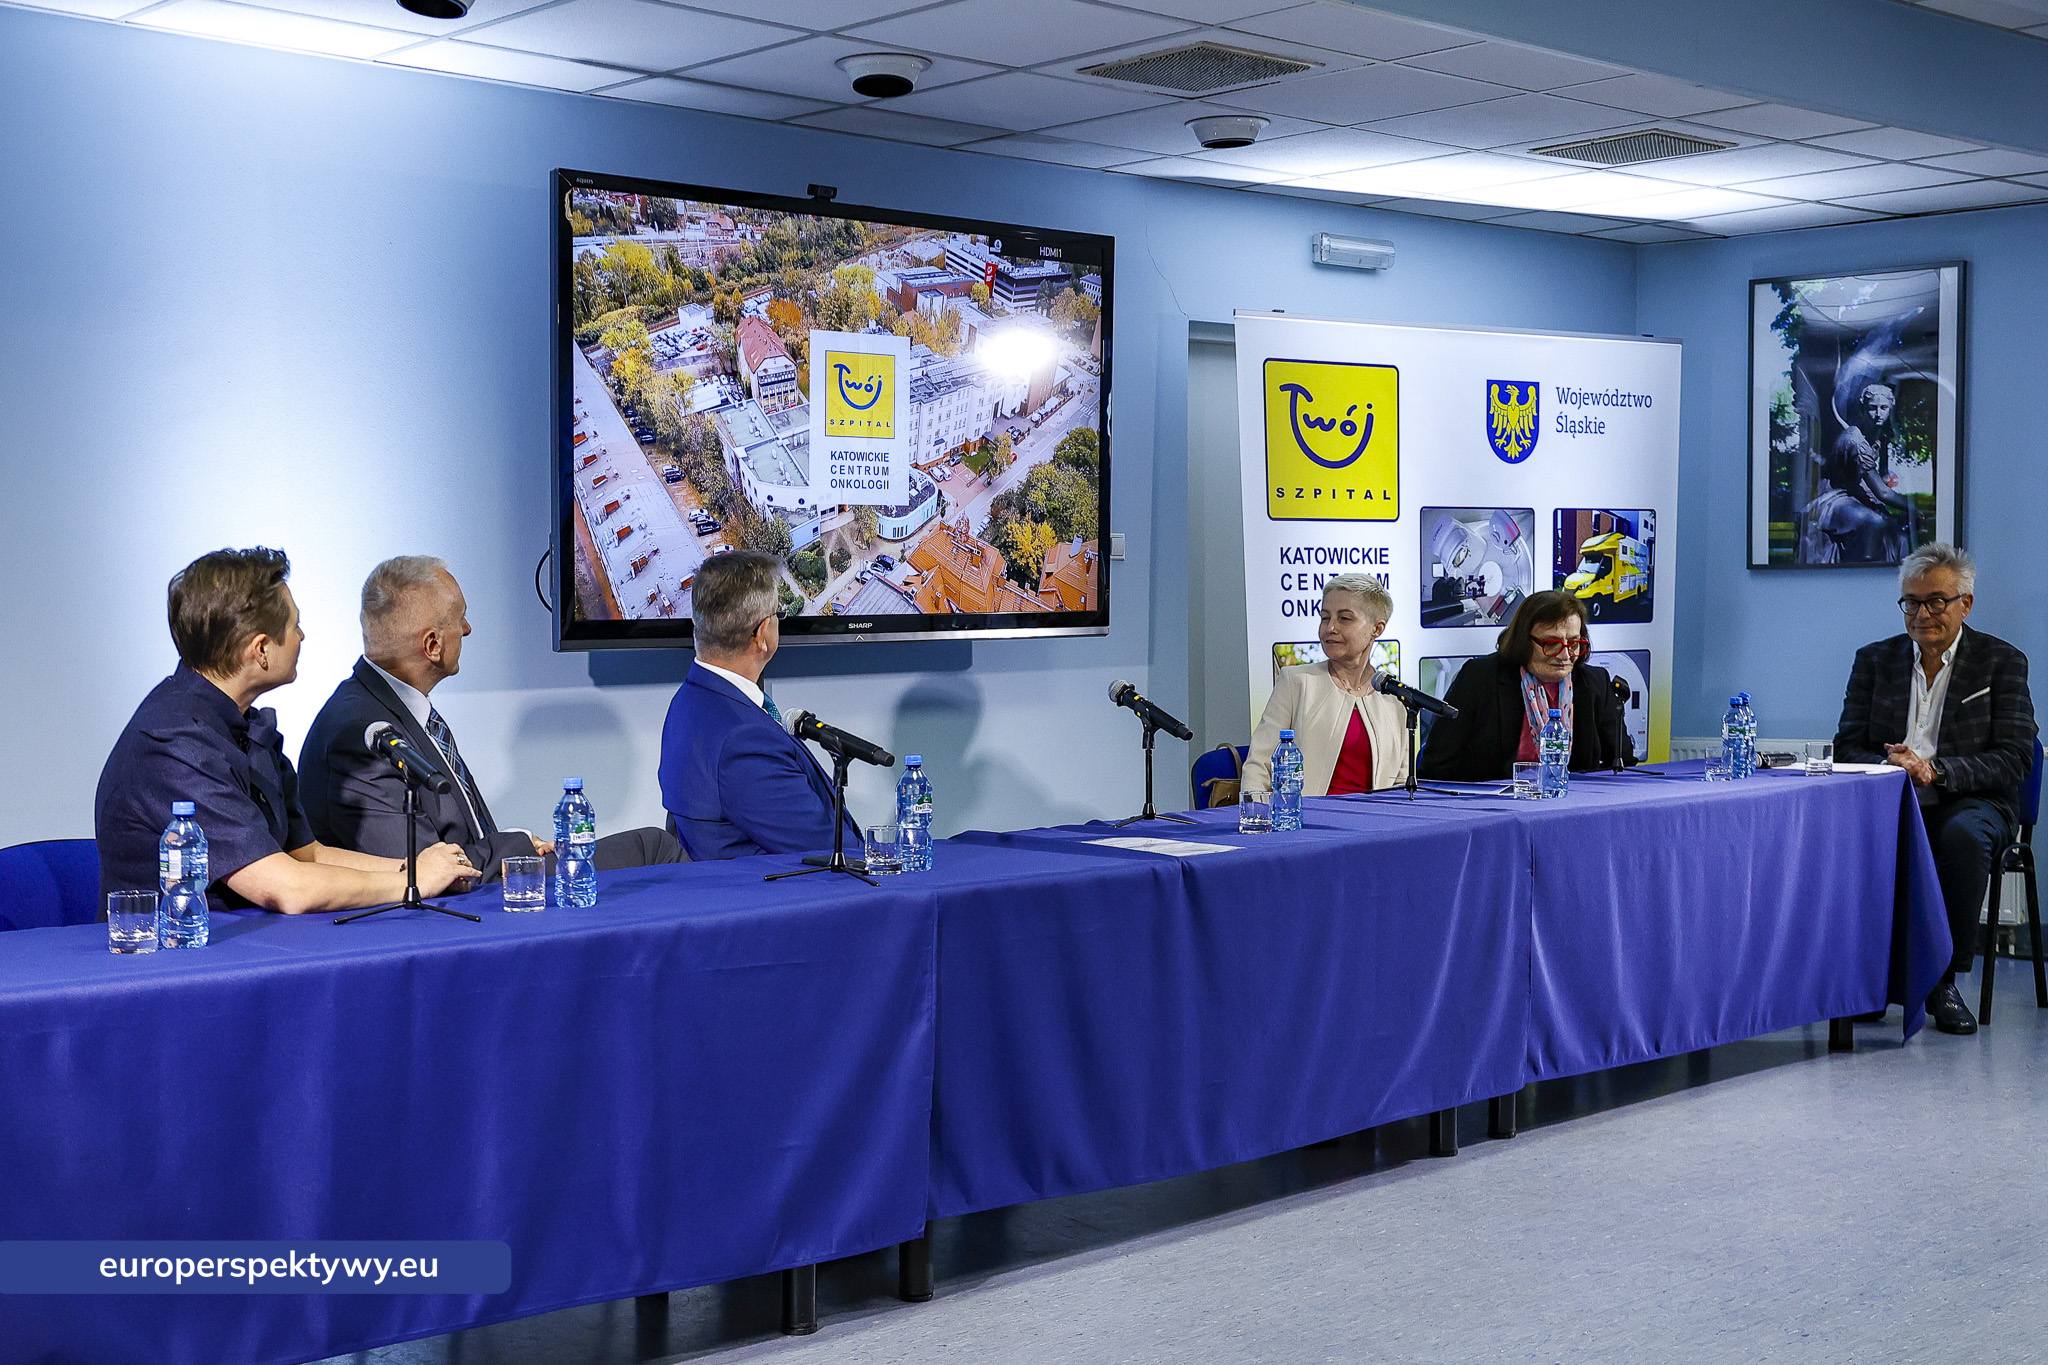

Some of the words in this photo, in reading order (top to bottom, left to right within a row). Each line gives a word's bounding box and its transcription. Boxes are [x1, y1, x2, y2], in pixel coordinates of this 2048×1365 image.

[1039, 246, 1062, 259] HDMI1
[833, 363, 882, 410] Twój
[1555, 386, 1653, 410] Województwo
[829, 418, 891, 428] SZPITAL
[1279, 383, 1374, 469] Twój
[1555, 411, 1606, 439] Śląskie
[830, 450, 889, 462] KATOWICKIE
[830, 464, 889, 475] CENTRUM
[830, 478, 889, 489] ONKOLOGII
[1276, 487, 1391, 500] SZPITAL
[1279, 546, 1390, 565] KATOWICKIE
[1280, 572, 1390, 591] CENM
